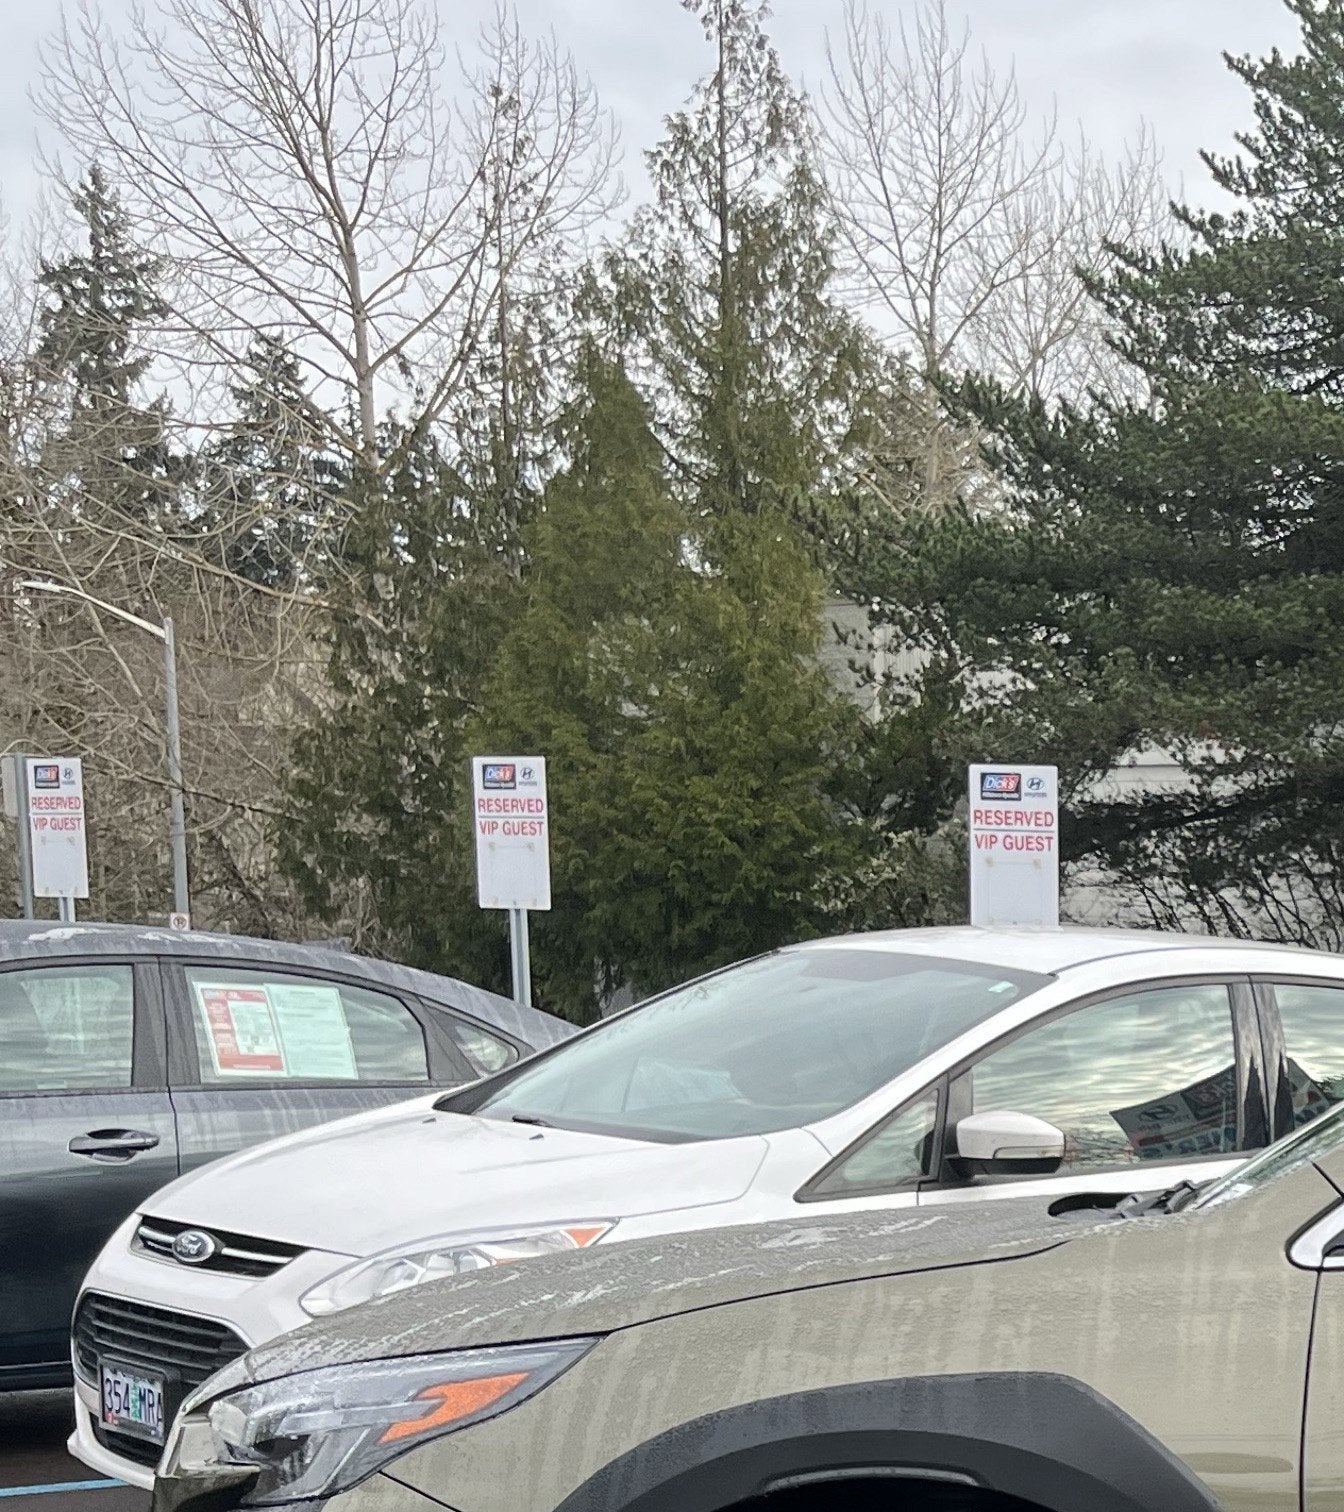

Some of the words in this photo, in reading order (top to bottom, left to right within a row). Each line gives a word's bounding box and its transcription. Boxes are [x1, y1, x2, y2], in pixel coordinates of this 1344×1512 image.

[31, 796, 81, 810] RESERVED
[477, 799, 544, 813] RESERVED
[33, 818, 48, 830] VIP
[50, 817, 82, 831] GUEST
[973, 809, 1054, 827] RESERVED
[479, 821, 499, 835] VIP
[502, 820, 545, 836] GUEST
[975, 834, 998, 849] VIP
[1003, 834, 1053, 851] GUEST
[105, 1377, 130, 1419] 354
